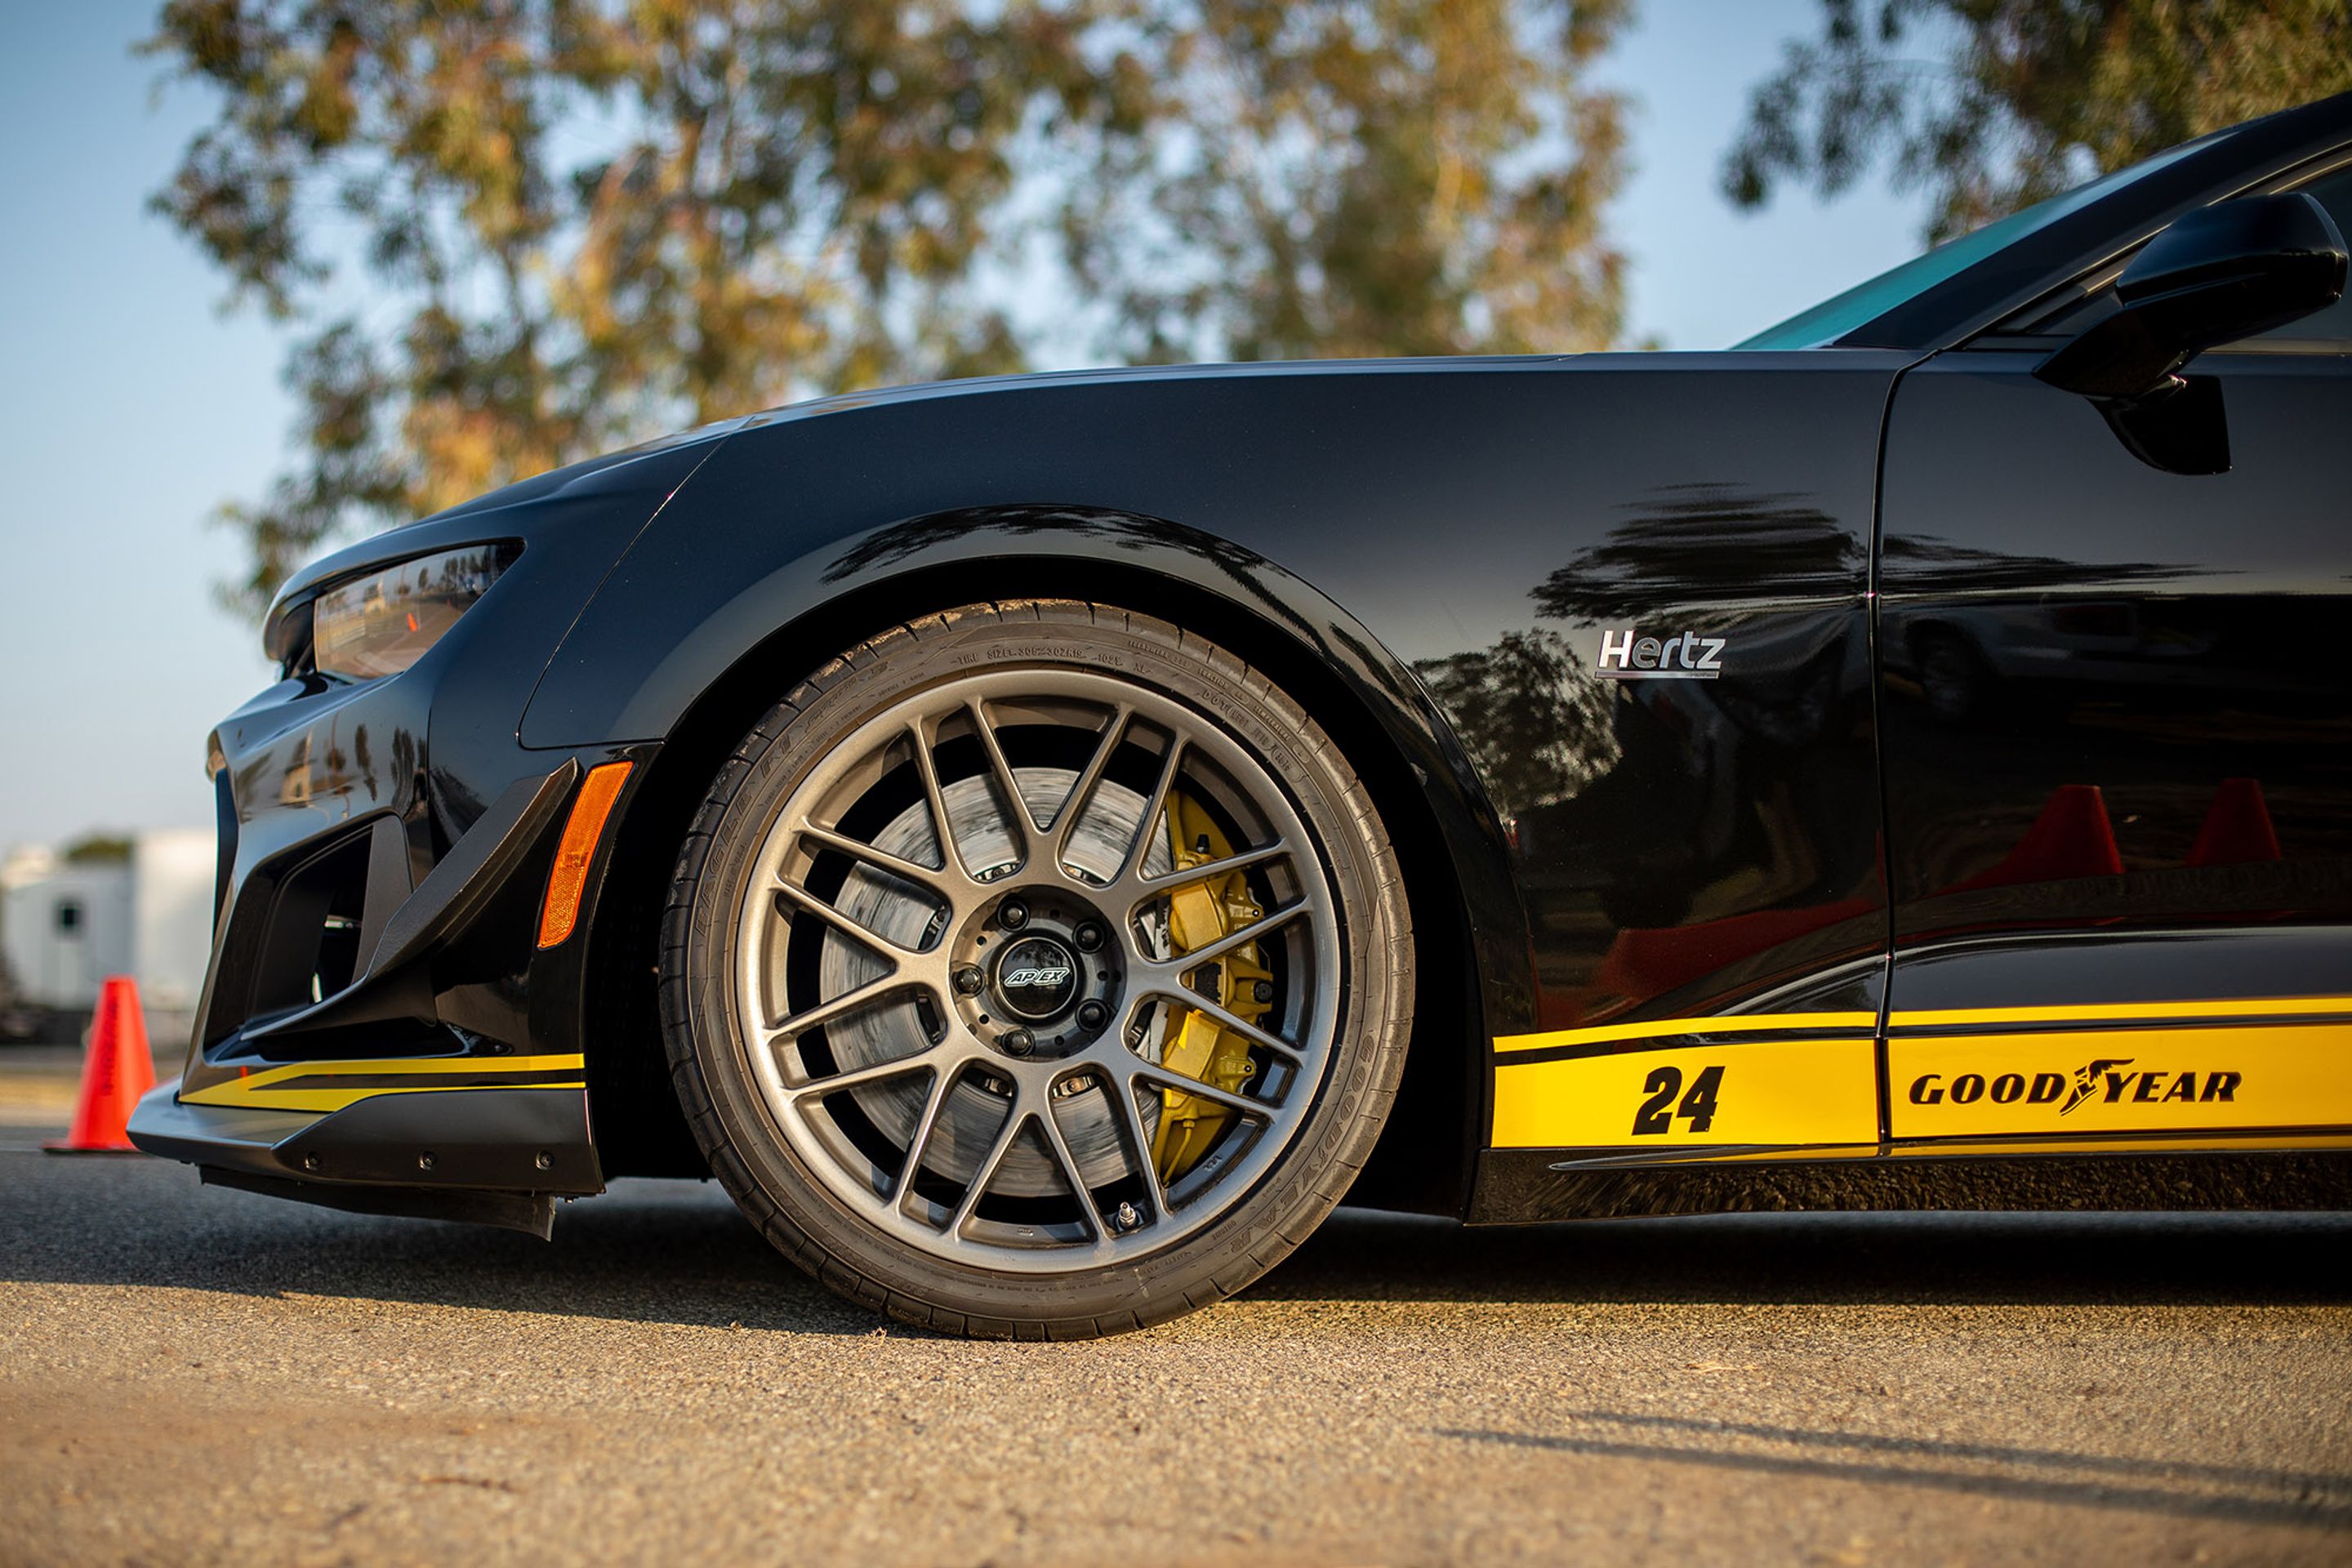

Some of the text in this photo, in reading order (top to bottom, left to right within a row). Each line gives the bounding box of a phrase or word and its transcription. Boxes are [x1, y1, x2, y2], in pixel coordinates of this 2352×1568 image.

[1598, 630, 1726, 670] Hertz
[1201, 690, 1230, 711] DOT
[693, 790, 755, 938] EAGLE
[1005, 968, 1069, 987] APEX
[1631, 1066, 1726, 1136] 24
[1909, 1069, 2242, 1107] GOODYEAR
[1228, 1035, 1375, 1254] GOODYEAR
